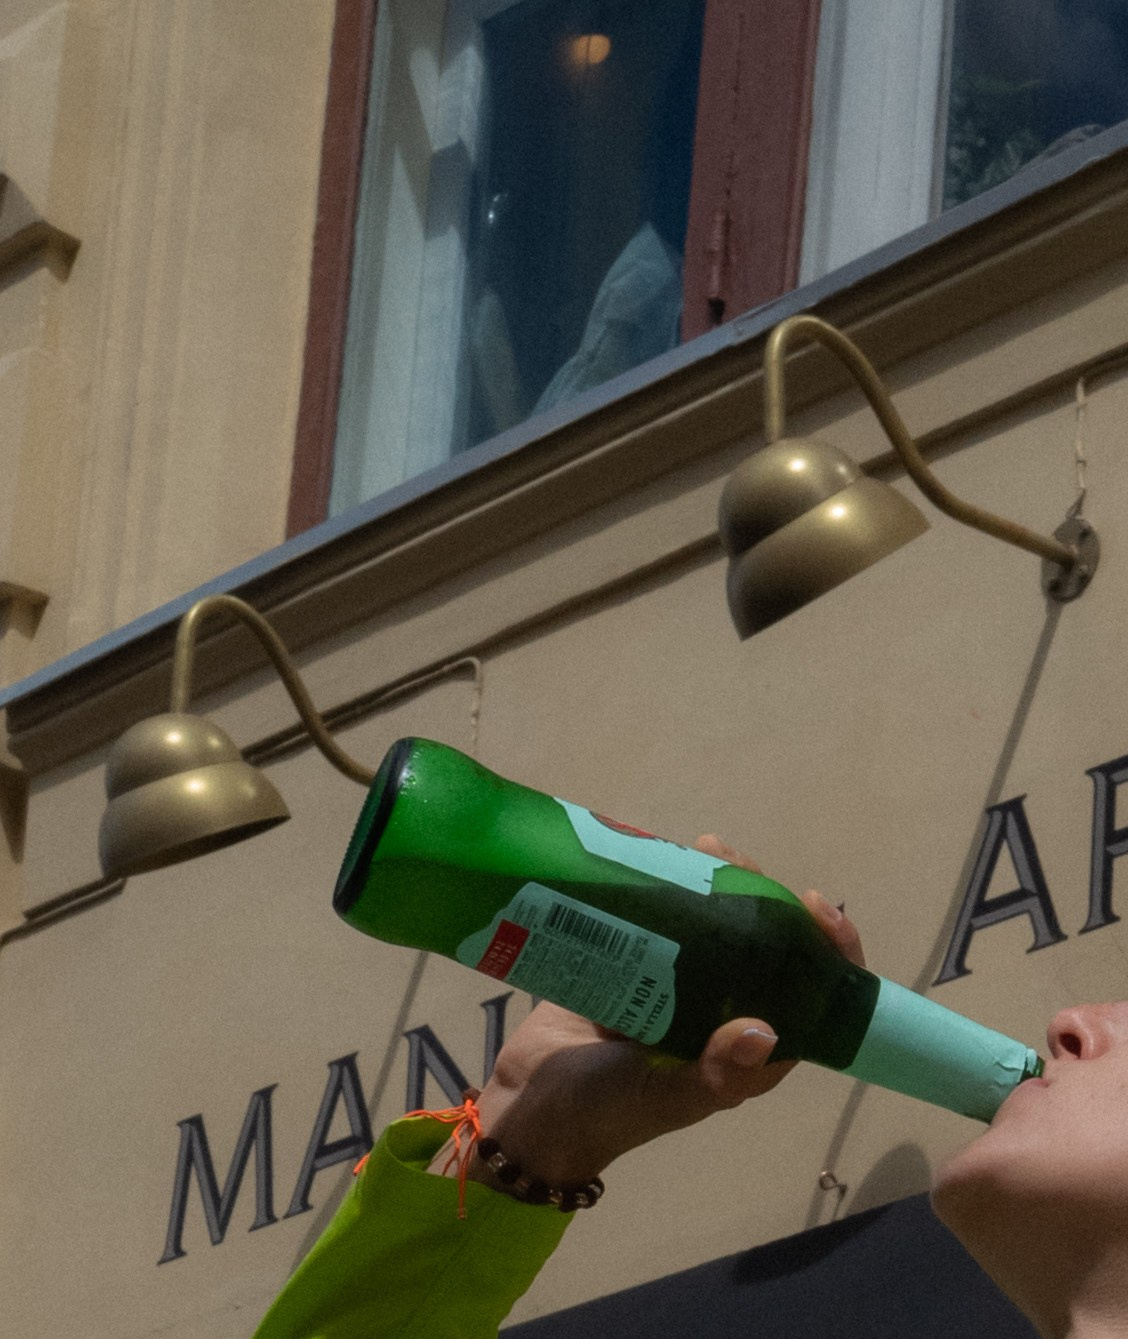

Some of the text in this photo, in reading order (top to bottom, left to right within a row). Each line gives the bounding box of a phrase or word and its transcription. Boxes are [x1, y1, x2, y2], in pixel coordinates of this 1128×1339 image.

[630, 975, 658, 1009] NON
[645, 993, 669, 1025] STELLA
[157, 991, 514, 1266] MAN
